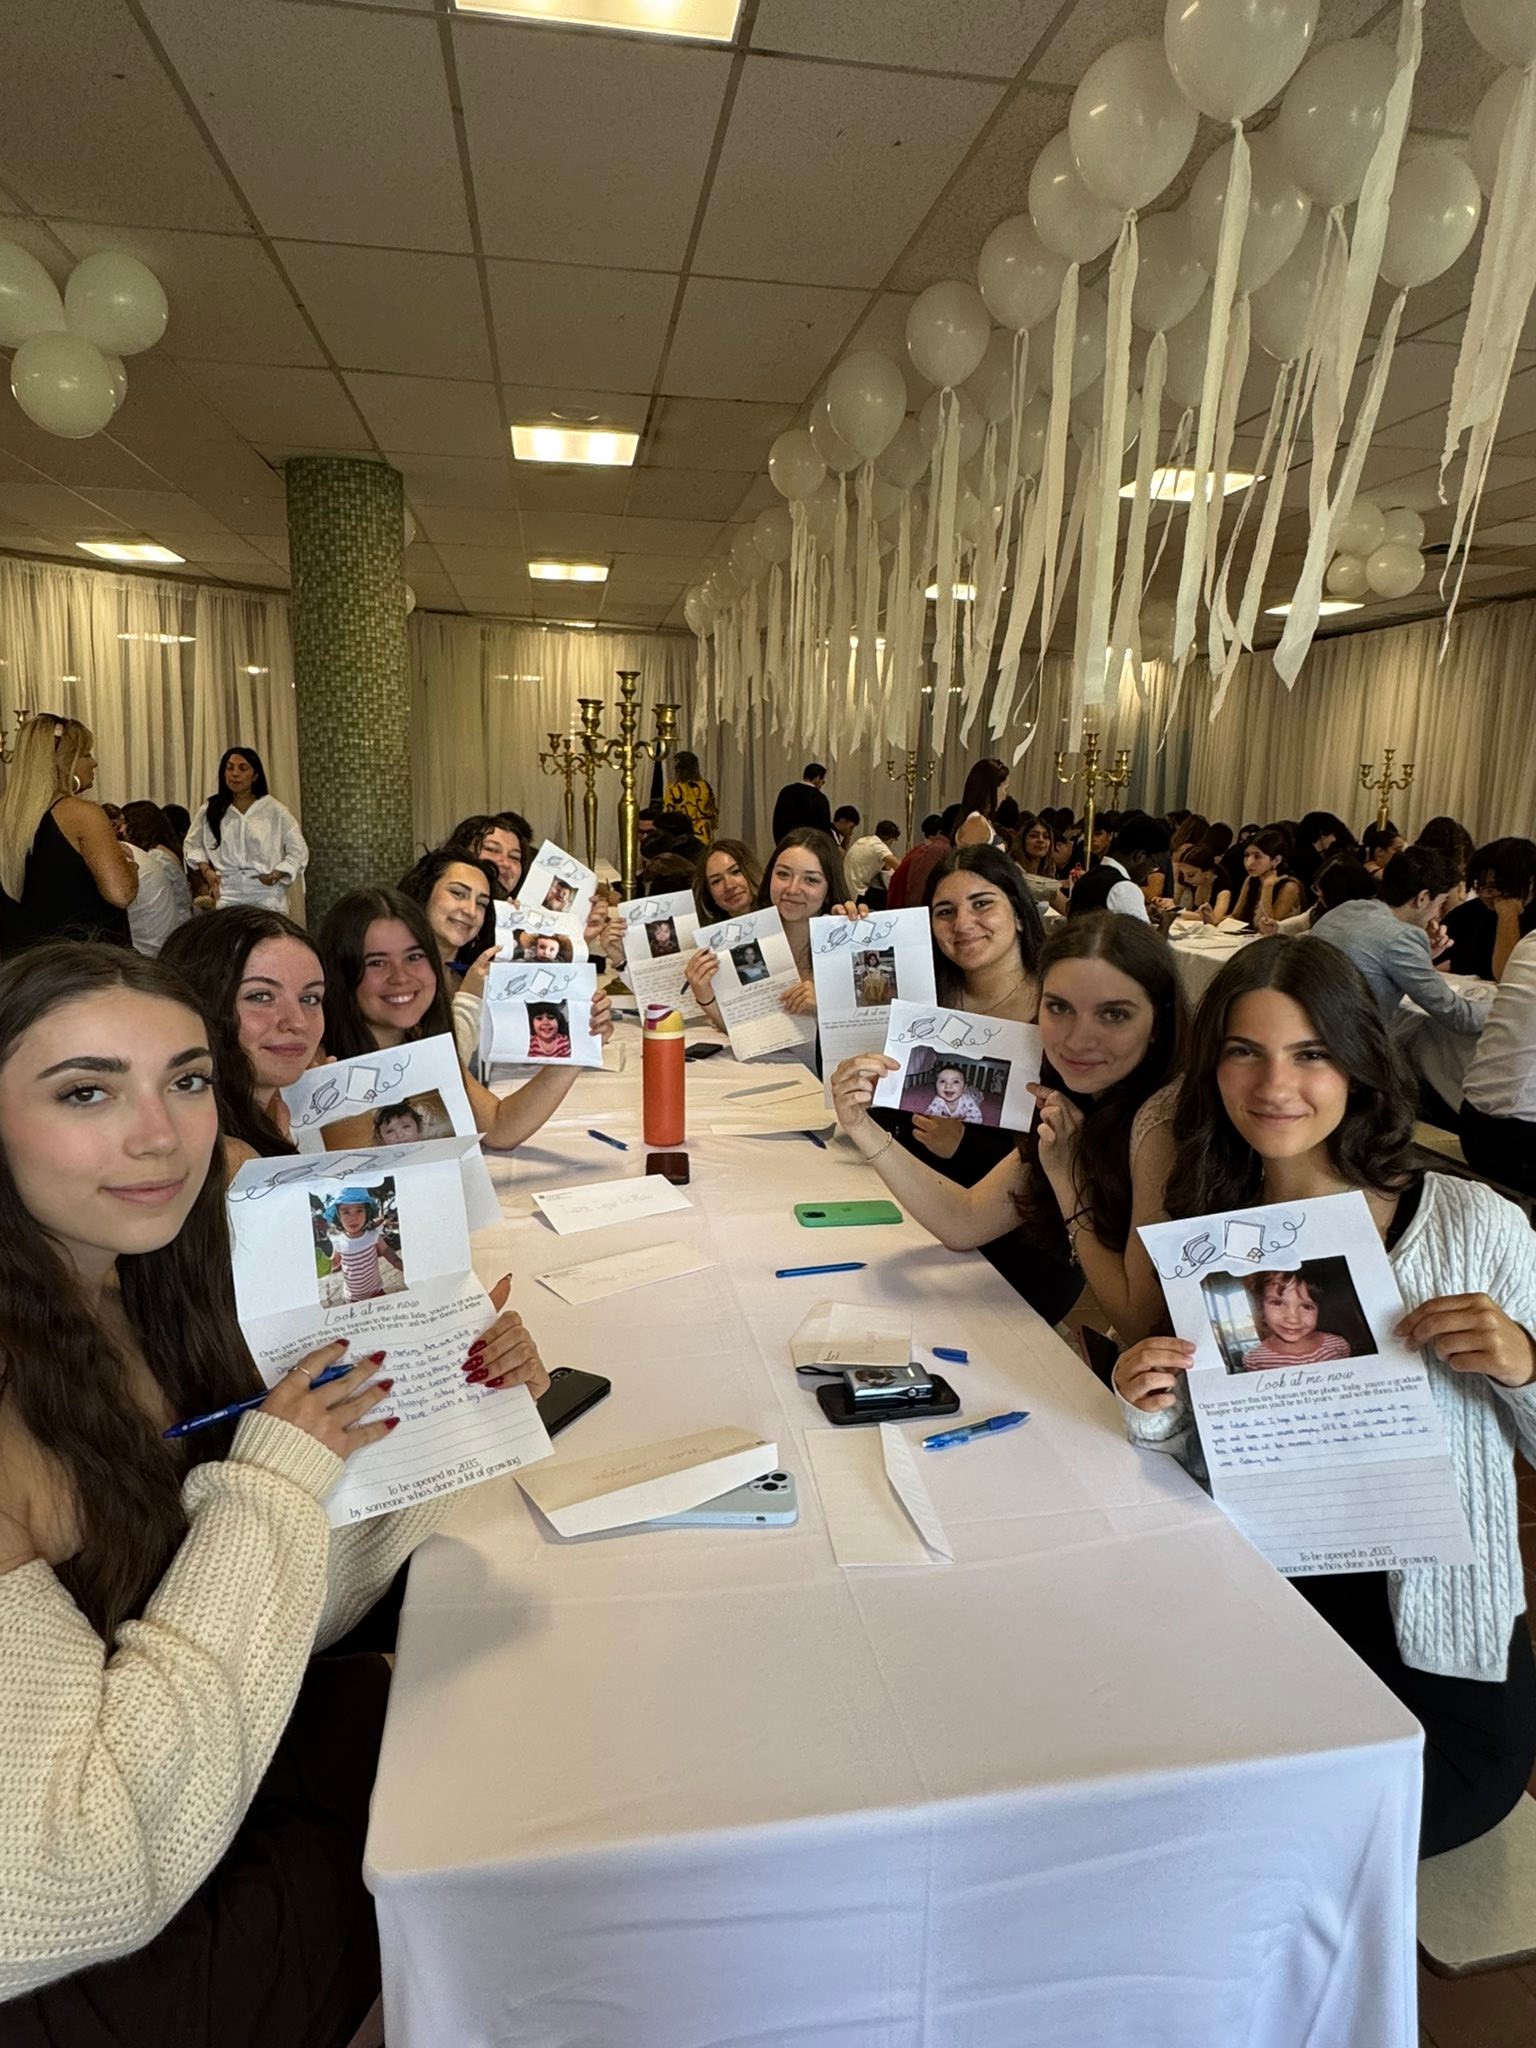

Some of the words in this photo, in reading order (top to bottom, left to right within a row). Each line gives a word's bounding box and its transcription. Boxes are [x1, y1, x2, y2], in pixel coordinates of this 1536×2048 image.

[325, 1307, 357, 1326] Look
[377, 1303, 394, 1312] me
[397, 1299, 419, 1310] now
[259, 1348, 281, 1358] Once
[281, 1340, 297, 1352] you
[301, 1341, 315, 1350] the
[1256, 1372, 1287, 1393] Look
[1306, 1374, 1324, 1385] me
[1328, 1371, 1354, 1381] now
[1199, 1402, 1217, 1410] Once
[1217, 1400, 1229, 1409] you
[1307, 1388, 1319, 1396] the
[1233, 1405, 1243, 1413] the
[349, 1507, 362, 1519] by
[365, 1495, 405, 1513] someone
[433, 1479, 455, 1493] done
[464, 1470, 475, 1481] lot
[476, 1466, 485, 1477] of
[486, 1455, 522, 1476] growing
[388, 1484, 399, 1495] To
[398, 1482, 411, 1493] be
[411, 1470, 445, 1490] opened
[446, 1467, 456, 1477] in
[1297, 1551, 1311, 1561] To
[1311, 1550, 1322, 1561] be
[1324, 1548, 1357, 1562] opened
[1344, 1559, 1365, 1569] done
[1374, 1556, 1387, 1567] lot
[1399, 1555, 1438, 1568] growing
